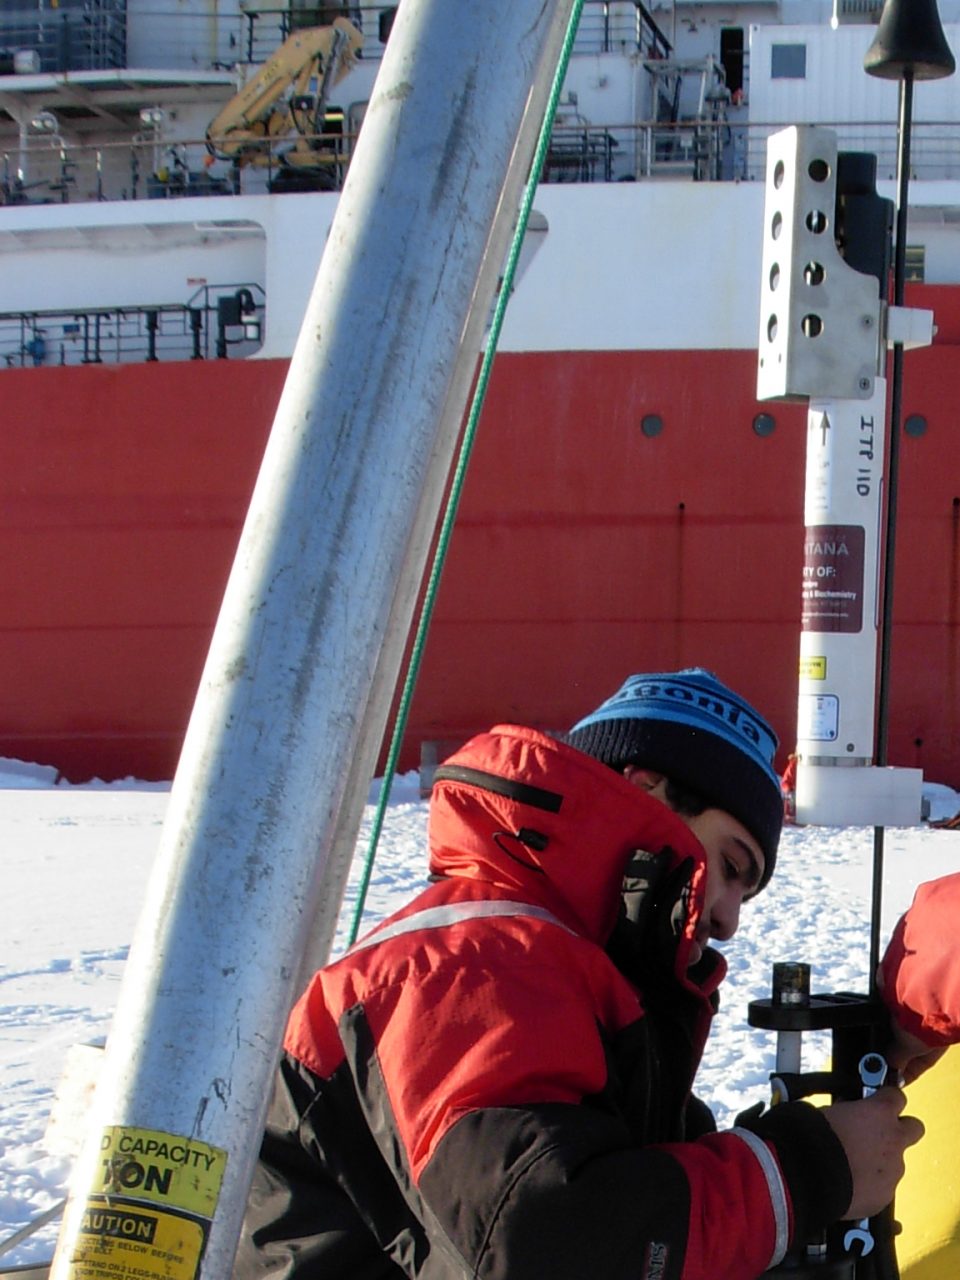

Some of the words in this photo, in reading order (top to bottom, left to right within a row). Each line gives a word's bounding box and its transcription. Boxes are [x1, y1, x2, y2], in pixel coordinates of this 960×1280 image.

[859, 415, 874, 460] ITP
[816, 566, 837, 577] OF:
[119, 1136, 216, 1171] CAPACITY
[103, 1159, 173, 1196] TON
[82, 1213, 153, 1238] AUTION
[118, 1241, 148, 1254] BELOW
[151, 1249, 184, 1264] BEFORE
[96, 1269, 124, 1280] TRIPOD
